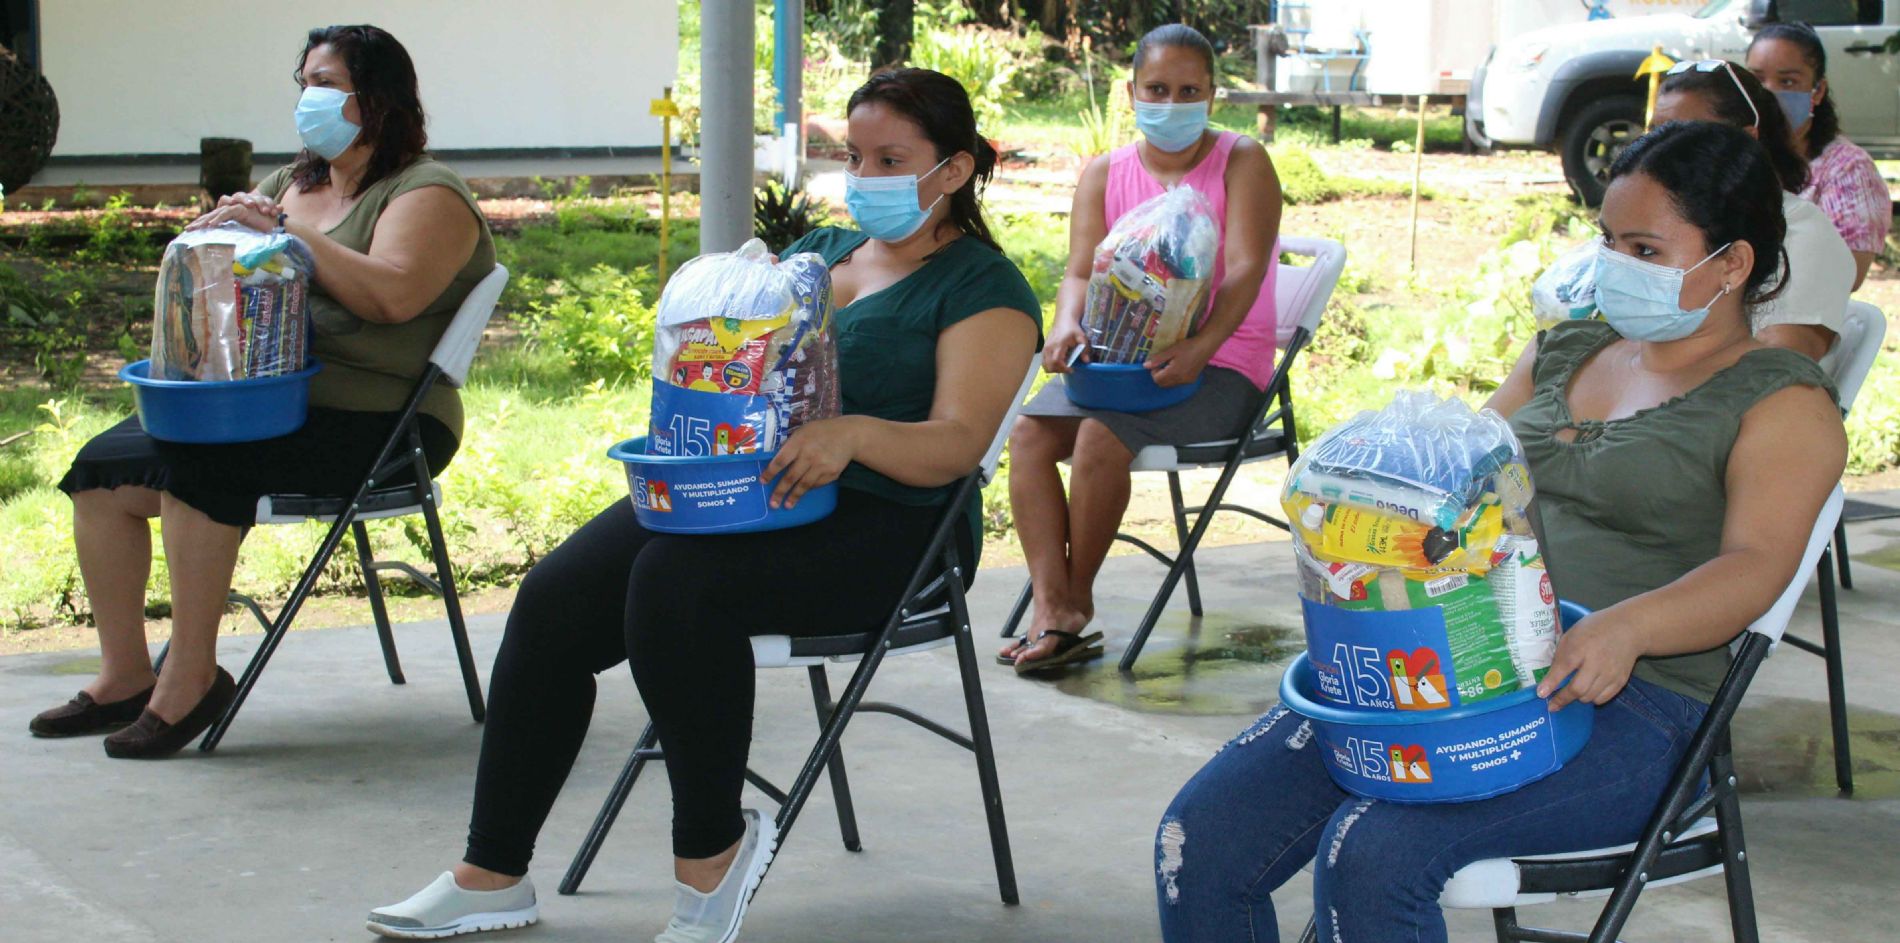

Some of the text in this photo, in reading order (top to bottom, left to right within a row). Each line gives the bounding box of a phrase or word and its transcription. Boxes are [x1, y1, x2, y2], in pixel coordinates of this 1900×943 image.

[669, 413, 711, 456] 15
[674, 475, 757, 491] AYUDANDO, SUMANDO
[682, 485, 749, 499] Y MULTIPLICANDO
[697, 499, 724, 508] SOMOS
[1318, 670, 1339, 686] Gloria
[1333, 643, 1391, 706] 15
[1320, 681, 1342, 696] Kriete
[1370, 699, 1395, 710] AÑOS
[1435, 716, 1546, 755] AYUDANDO, SUMANDO
[1449, 731, 1538, 763] Y MULTIPLICANDO
[1346, 736, 1389, 779] 15
[1471, 756, 1508, 772] SOMOS
[1371, 773, 1392, 783] AÑOS
